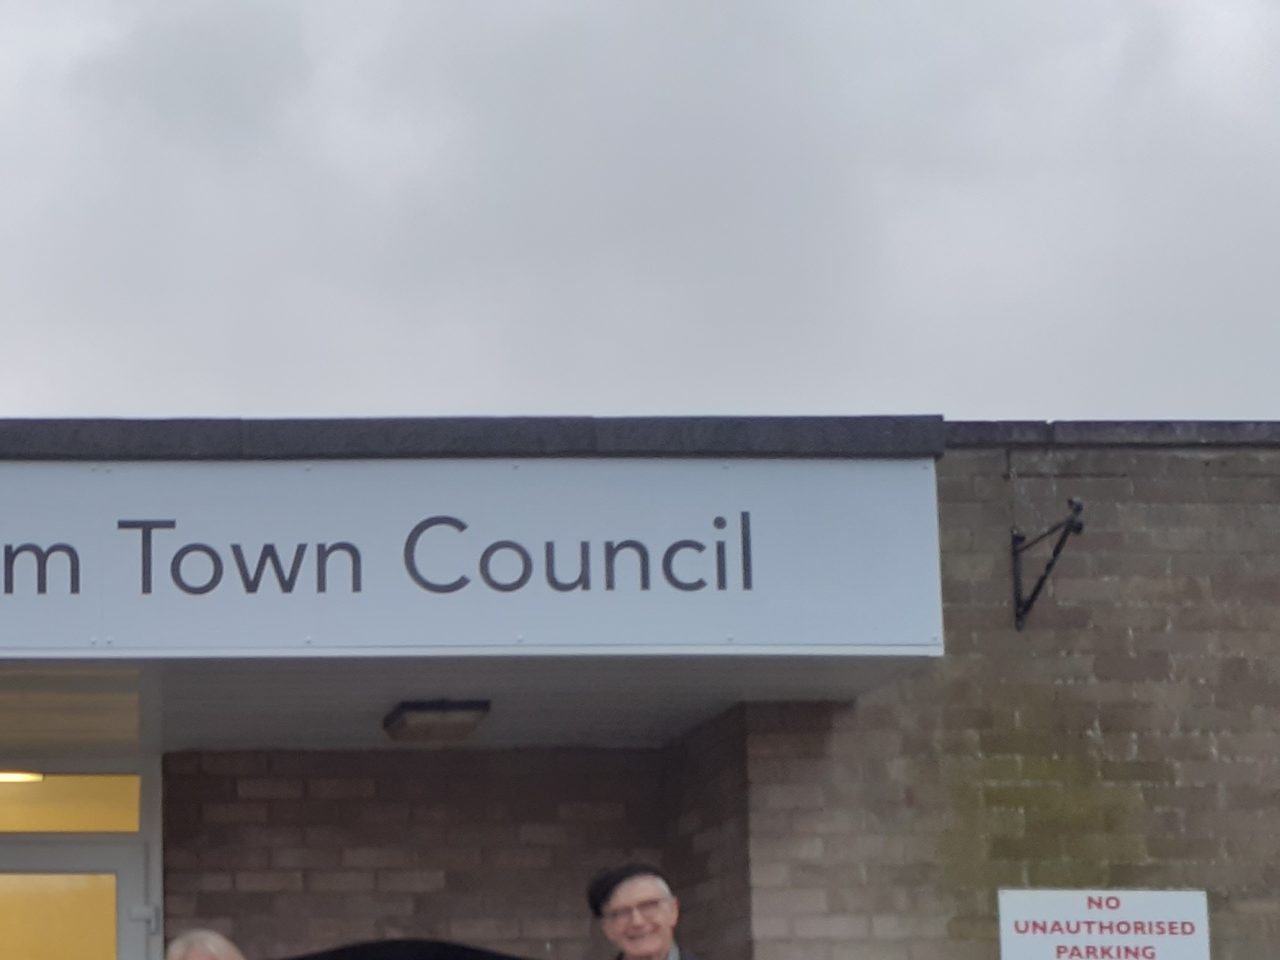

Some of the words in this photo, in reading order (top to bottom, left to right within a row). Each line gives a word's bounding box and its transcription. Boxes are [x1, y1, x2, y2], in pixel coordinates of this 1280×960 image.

[117, 519, 362, 596] Town
[403, 510, 753, 594] Council
[1087, 896, 1121, 910] NO
[1014, 920, 1196, 936] UNAUTHORISED
[1055, 945, 1156, 960] PARKING
